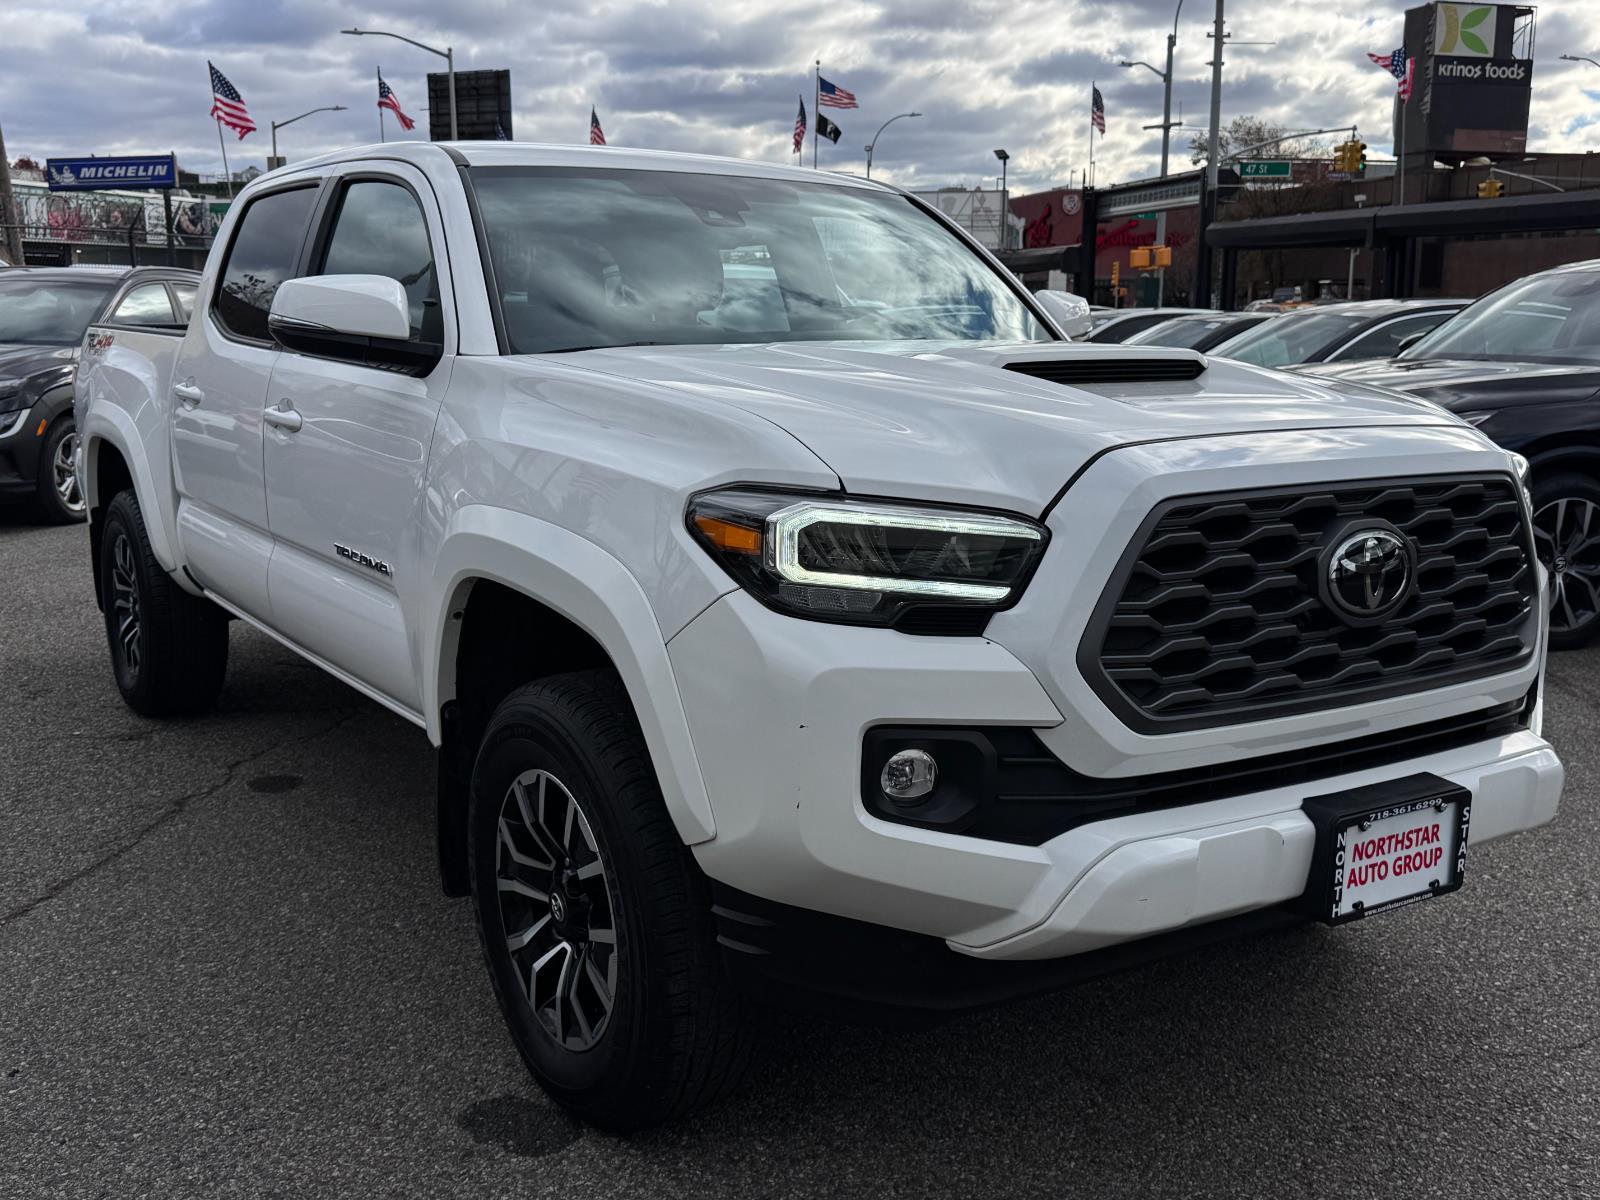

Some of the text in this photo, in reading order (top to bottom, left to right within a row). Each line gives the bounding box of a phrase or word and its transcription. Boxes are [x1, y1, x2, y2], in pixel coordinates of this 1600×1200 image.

[1485, 62, 1525, 79] foods
[80, 165, 168, 178] MICHELIN
[1245, 164, 1268, 174] 47 St
[333, 542, 391, 576] TACOMA
[1369, 798, 1442, 821] 718-361-6299
[1352, 824, 1440, 862] NORTHSTAR
[1457, 806, 1471, 873] STAR
[1331, 831, 1346, 918] NORTH
[1346, 847, 1443, 889] AUTO GROUP
